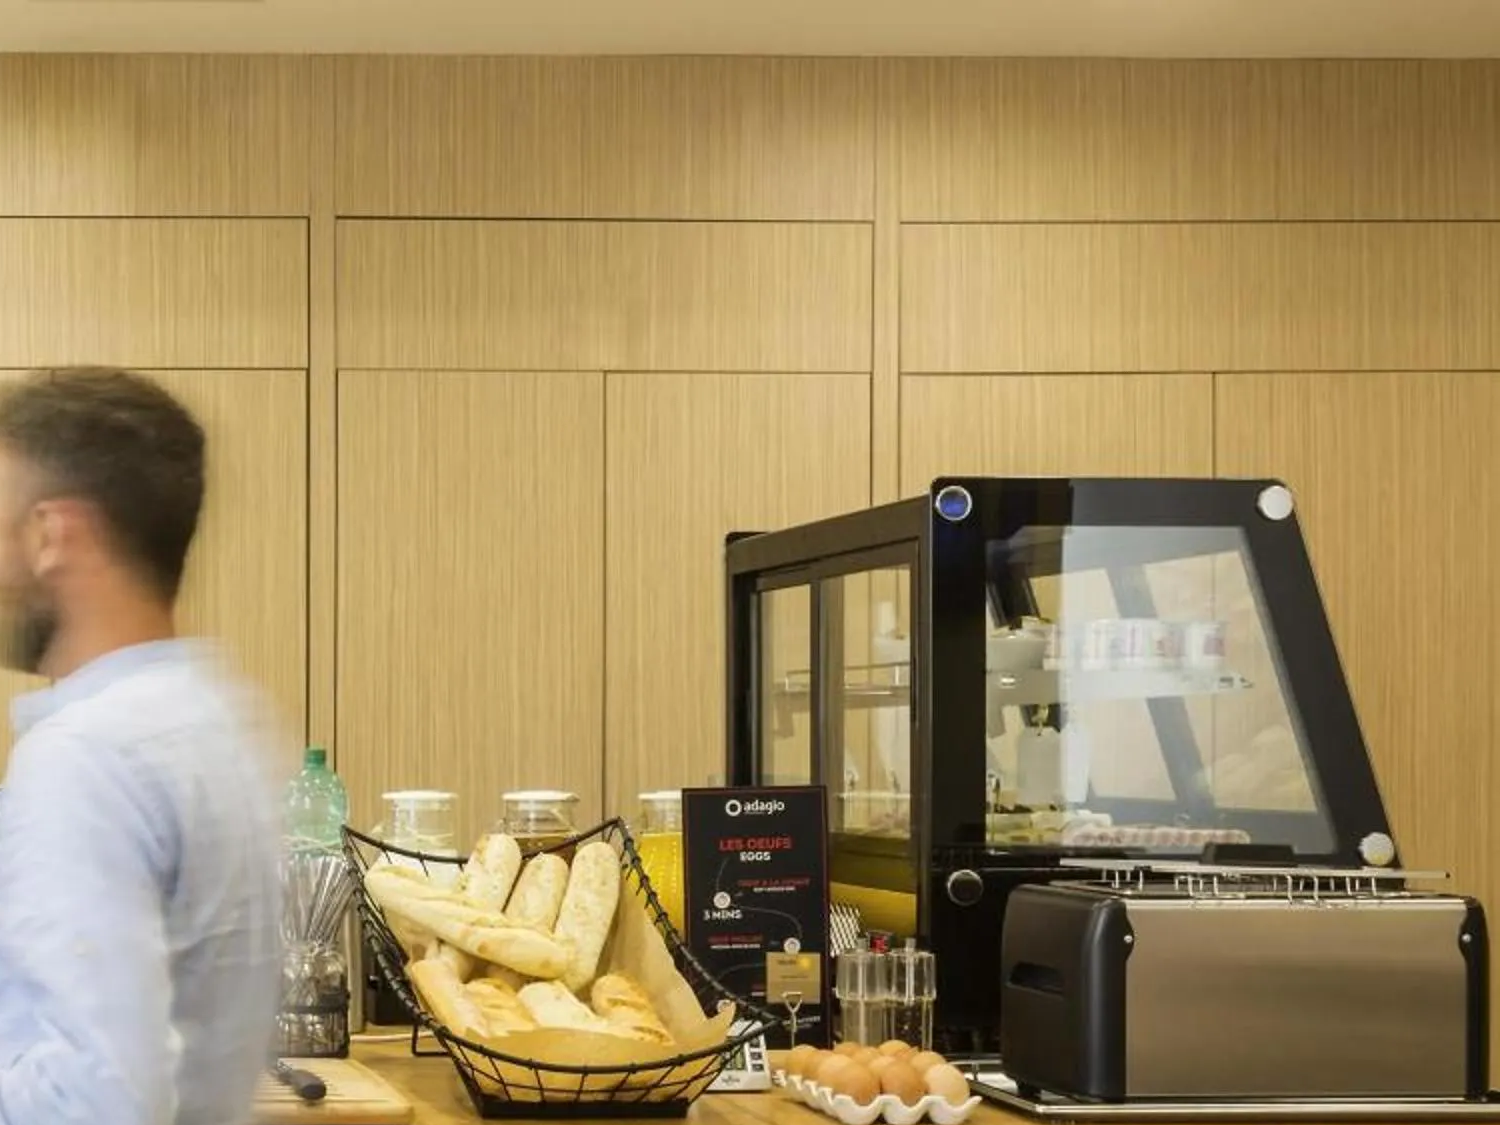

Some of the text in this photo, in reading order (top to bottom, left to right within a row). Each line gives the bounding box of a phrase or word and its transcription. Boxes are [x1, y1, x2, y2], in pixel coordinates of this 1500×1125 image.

[744, 799, 785, 815] adagio
[719, 836, 792, 851] LES OEUFS
[712, 909, 742, 919] MINS
